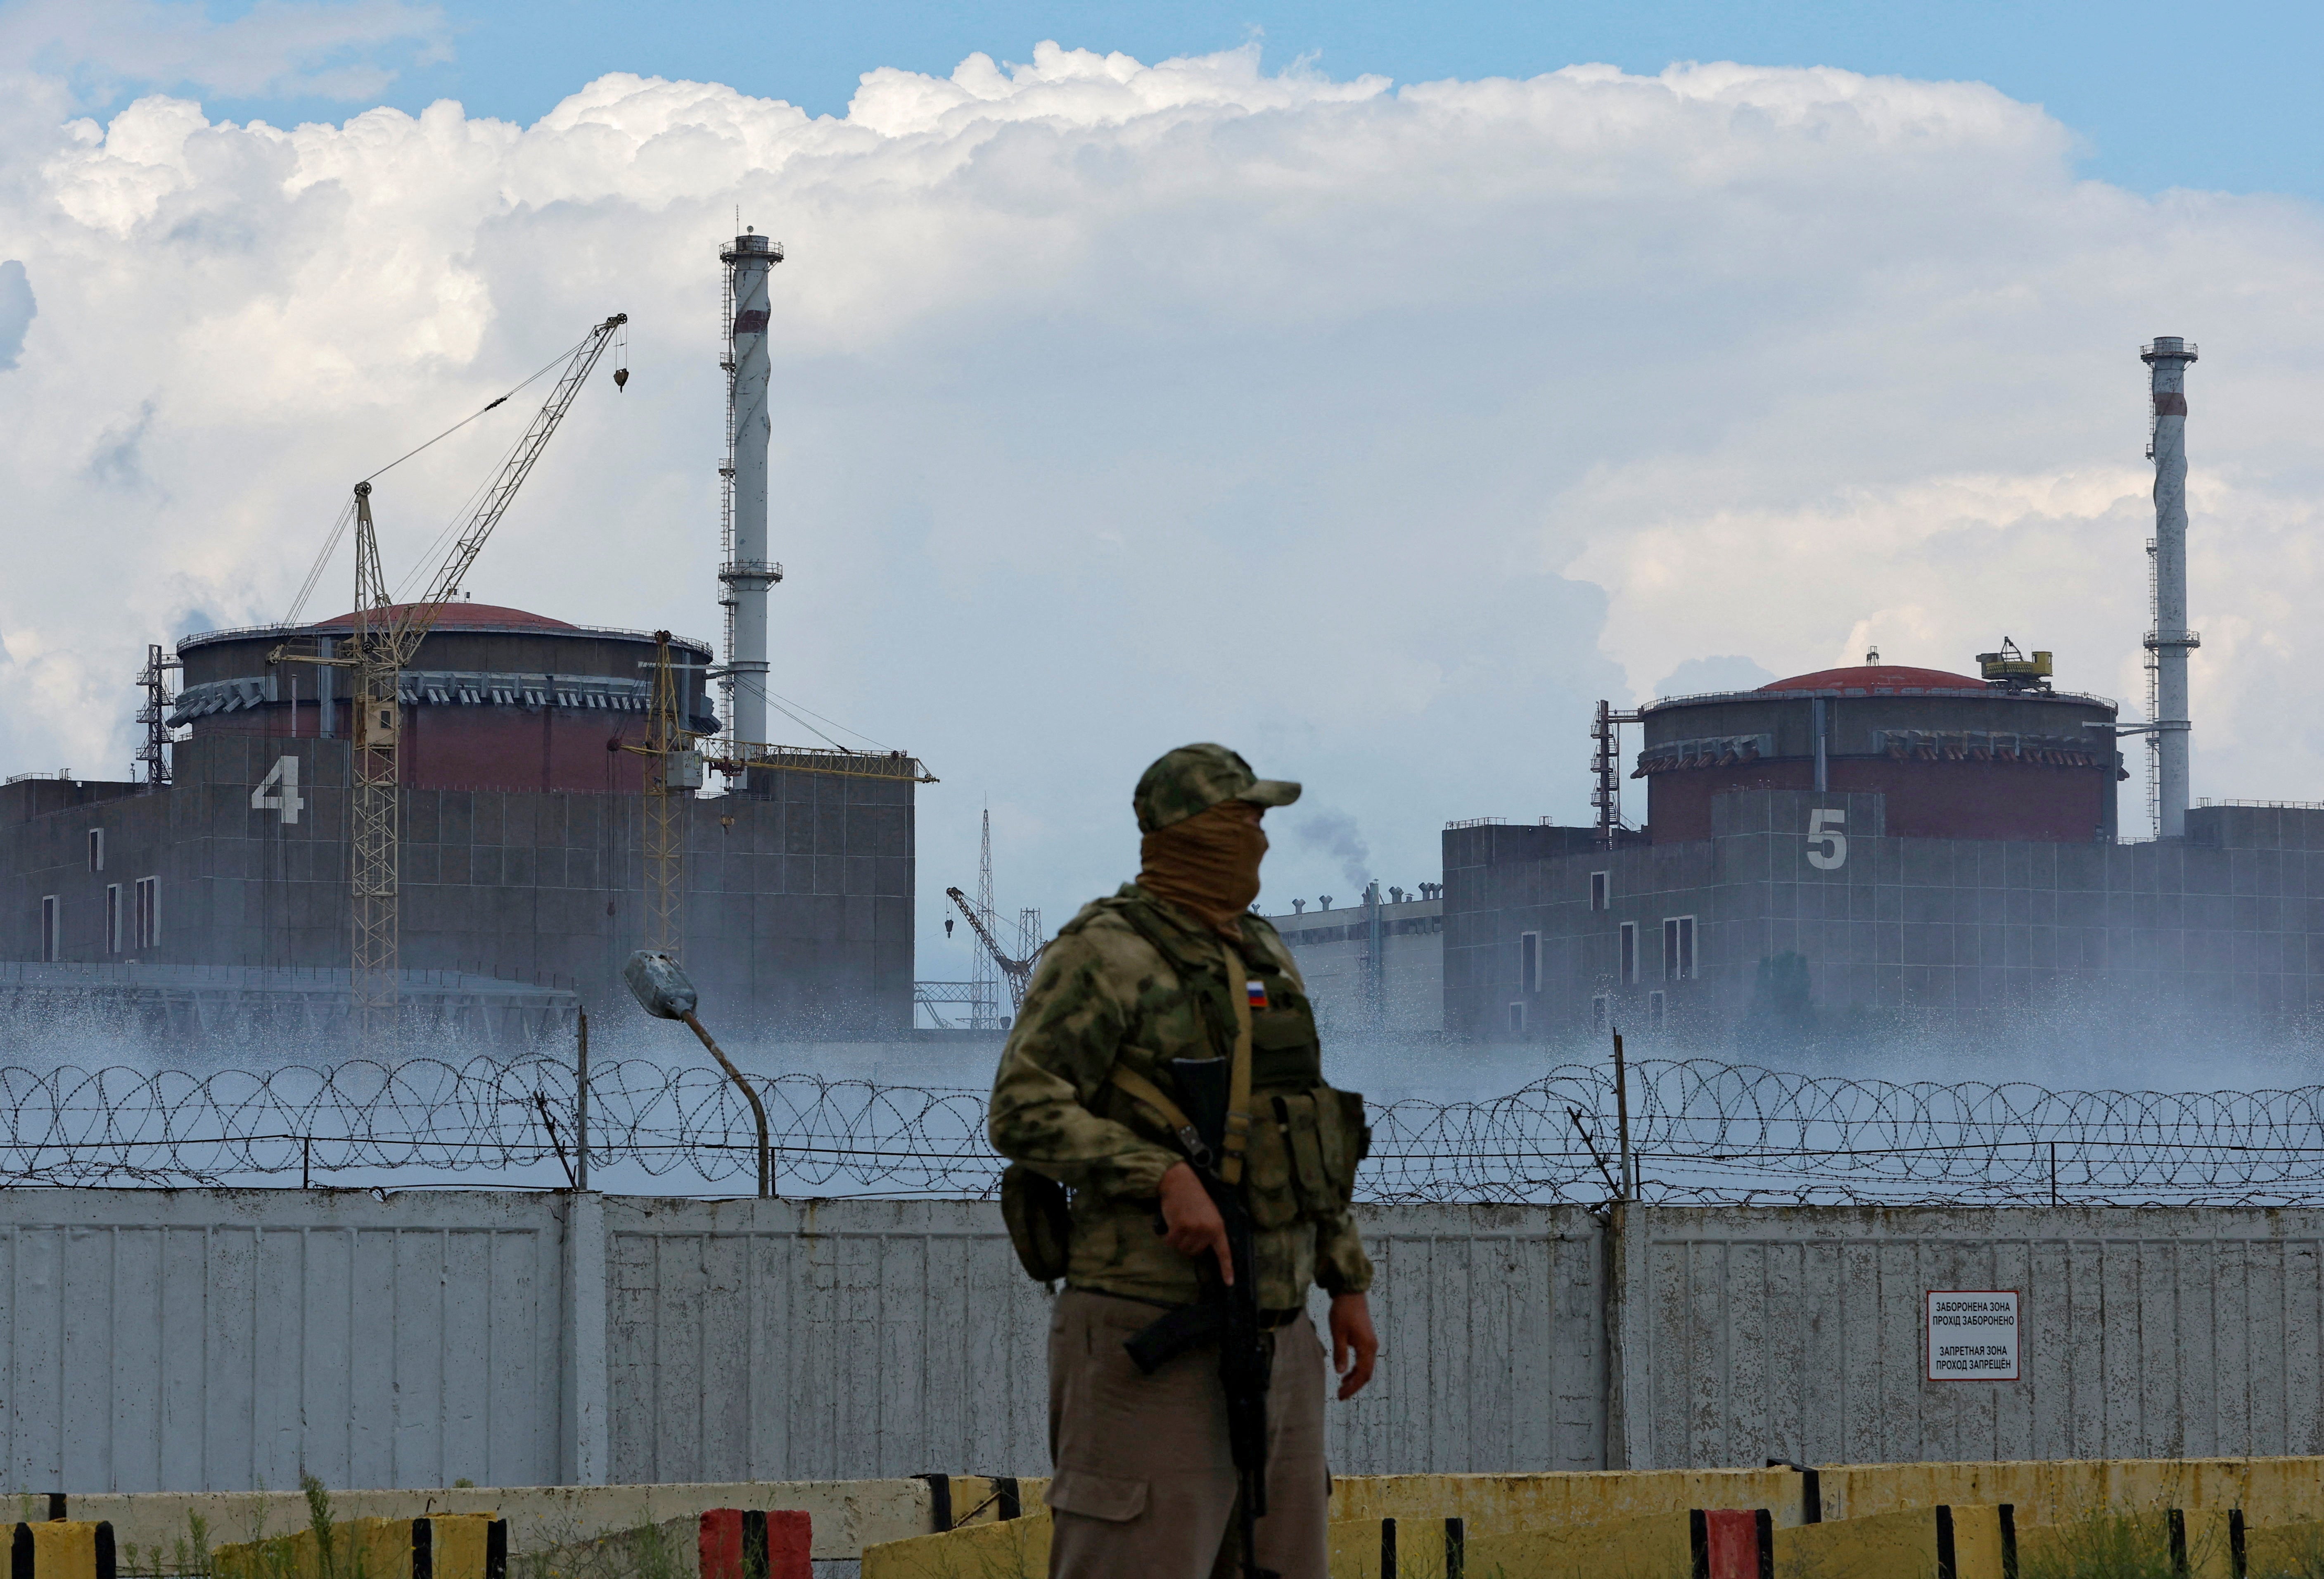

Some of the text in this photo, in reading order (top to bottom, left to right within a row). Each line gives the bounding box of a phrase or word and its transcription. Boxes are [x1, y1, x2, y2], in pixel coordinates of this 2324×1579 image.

[251, 755, 304, 824] 4
[1807, 809, 1847, 870] 5
[1936, 1302, 2010, 1311] ЗАБОРОНЕНА ЗОНА
[1933, 1315, 2014, 1327] ПРОХІД ЗАБОРОНЕНО
[1940, 1346, 2007, 1356] ЗАПРЕТНАЯ ЗОНА
[1936, 1358, 2011, 1371] ПРОХОД ЗАПРЕЩЁН
